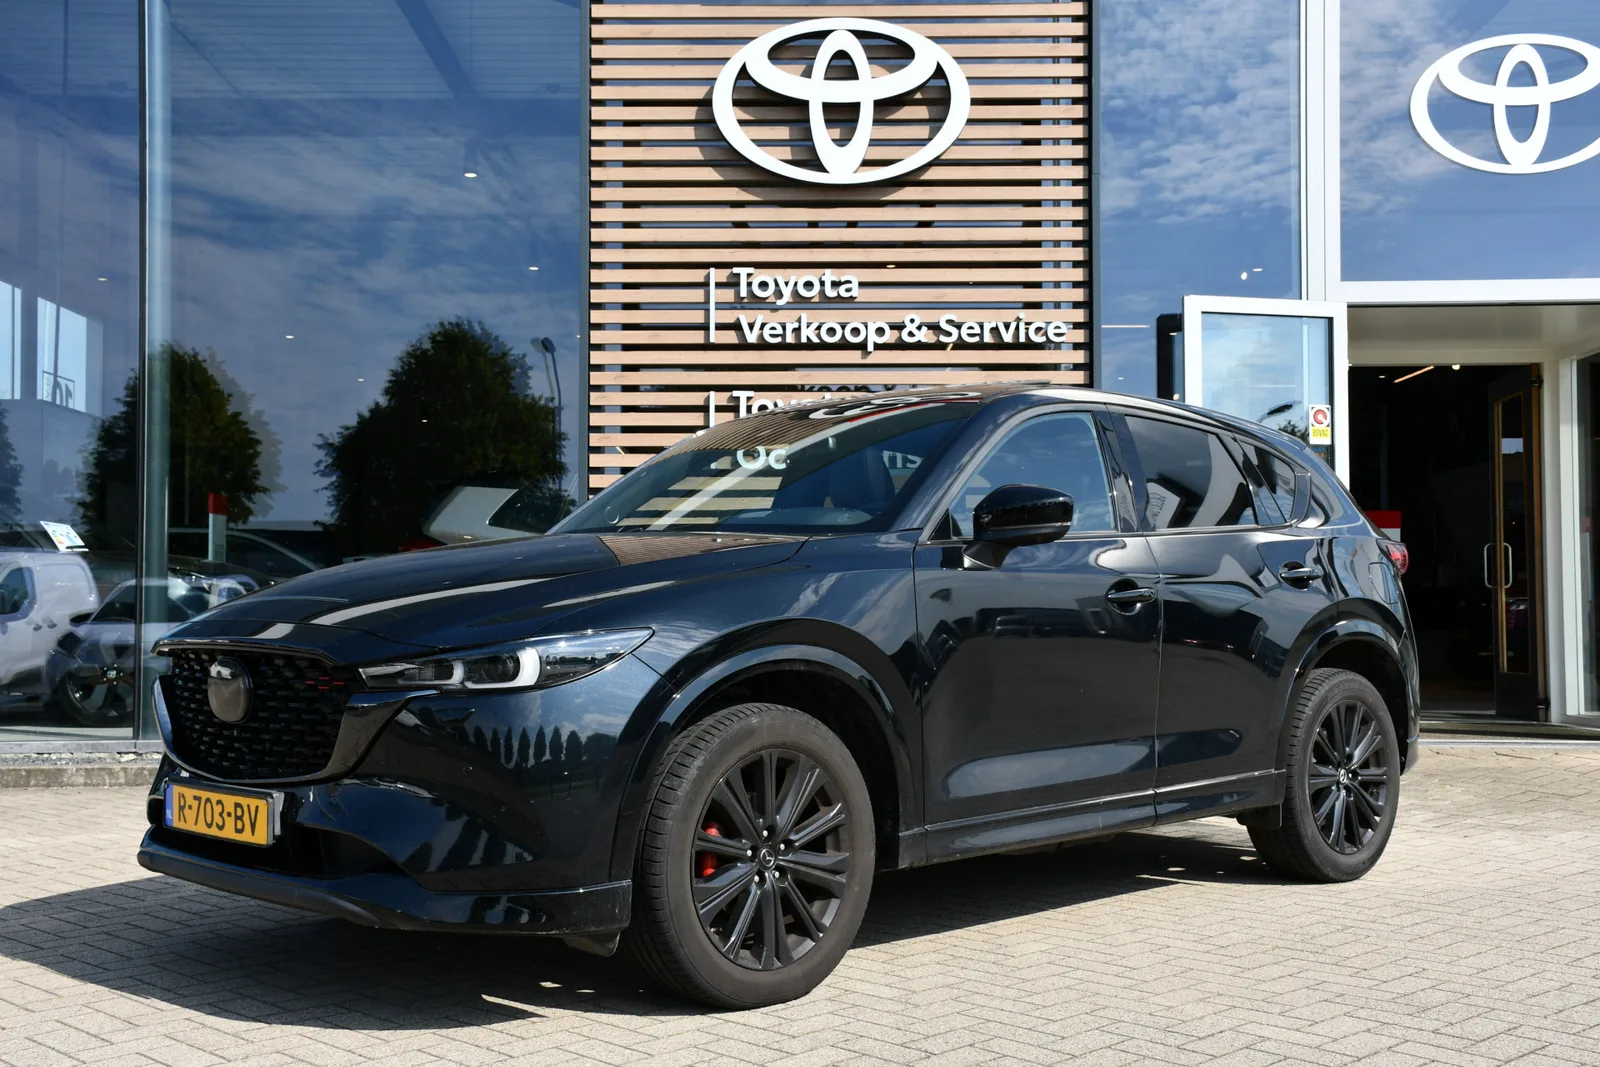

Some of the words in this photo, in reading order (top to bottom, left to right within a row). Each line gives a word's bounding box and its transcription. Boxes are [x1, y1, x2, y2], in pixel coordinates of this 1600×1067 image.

[732, 267, 859, 305] Toyota
[737, 313, 891, 351] Verkoop
[901, 314, 928, 343] &
[938, 313, 1068, 343] Service
[178, 791, 259, 836] R-703-BV
